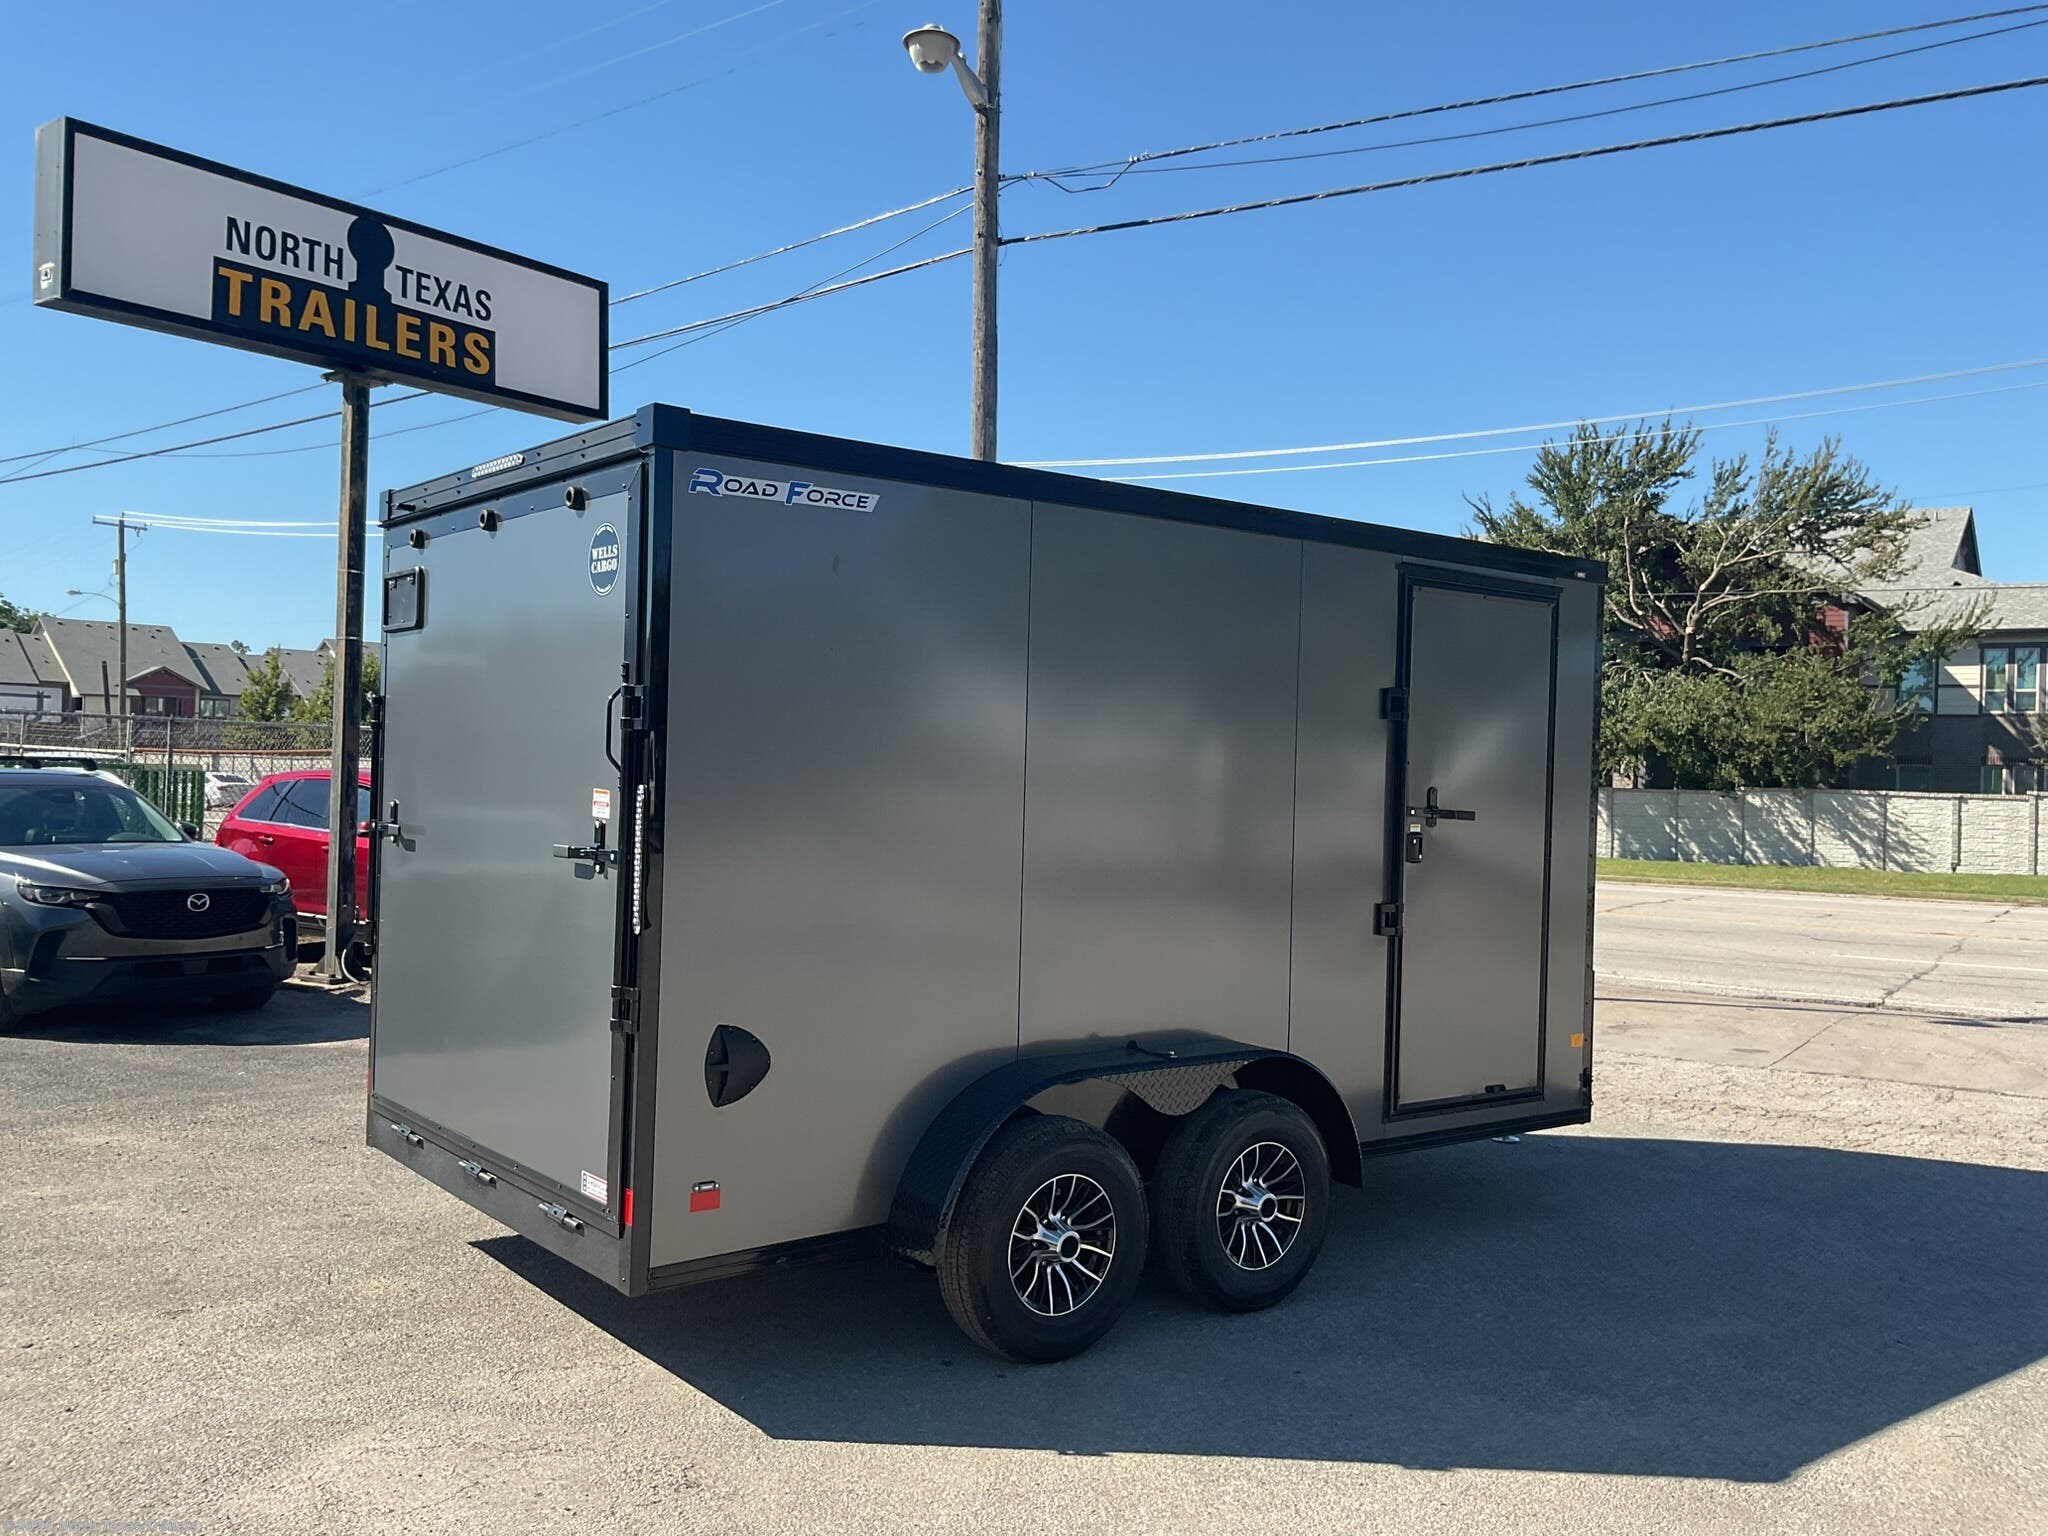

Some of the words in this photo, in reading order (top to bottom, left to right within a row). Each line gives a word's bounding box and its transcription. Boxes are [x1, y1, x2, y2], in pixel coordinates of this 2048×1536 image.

[226, 216, 344, 280] NORTH
[395, 265, 492, 321] TEXAS
[218, 267, 490, 375] TRAILERS
[591, 558, 618, 574] CARGO
[592, 544, 618, 560] WELLS
